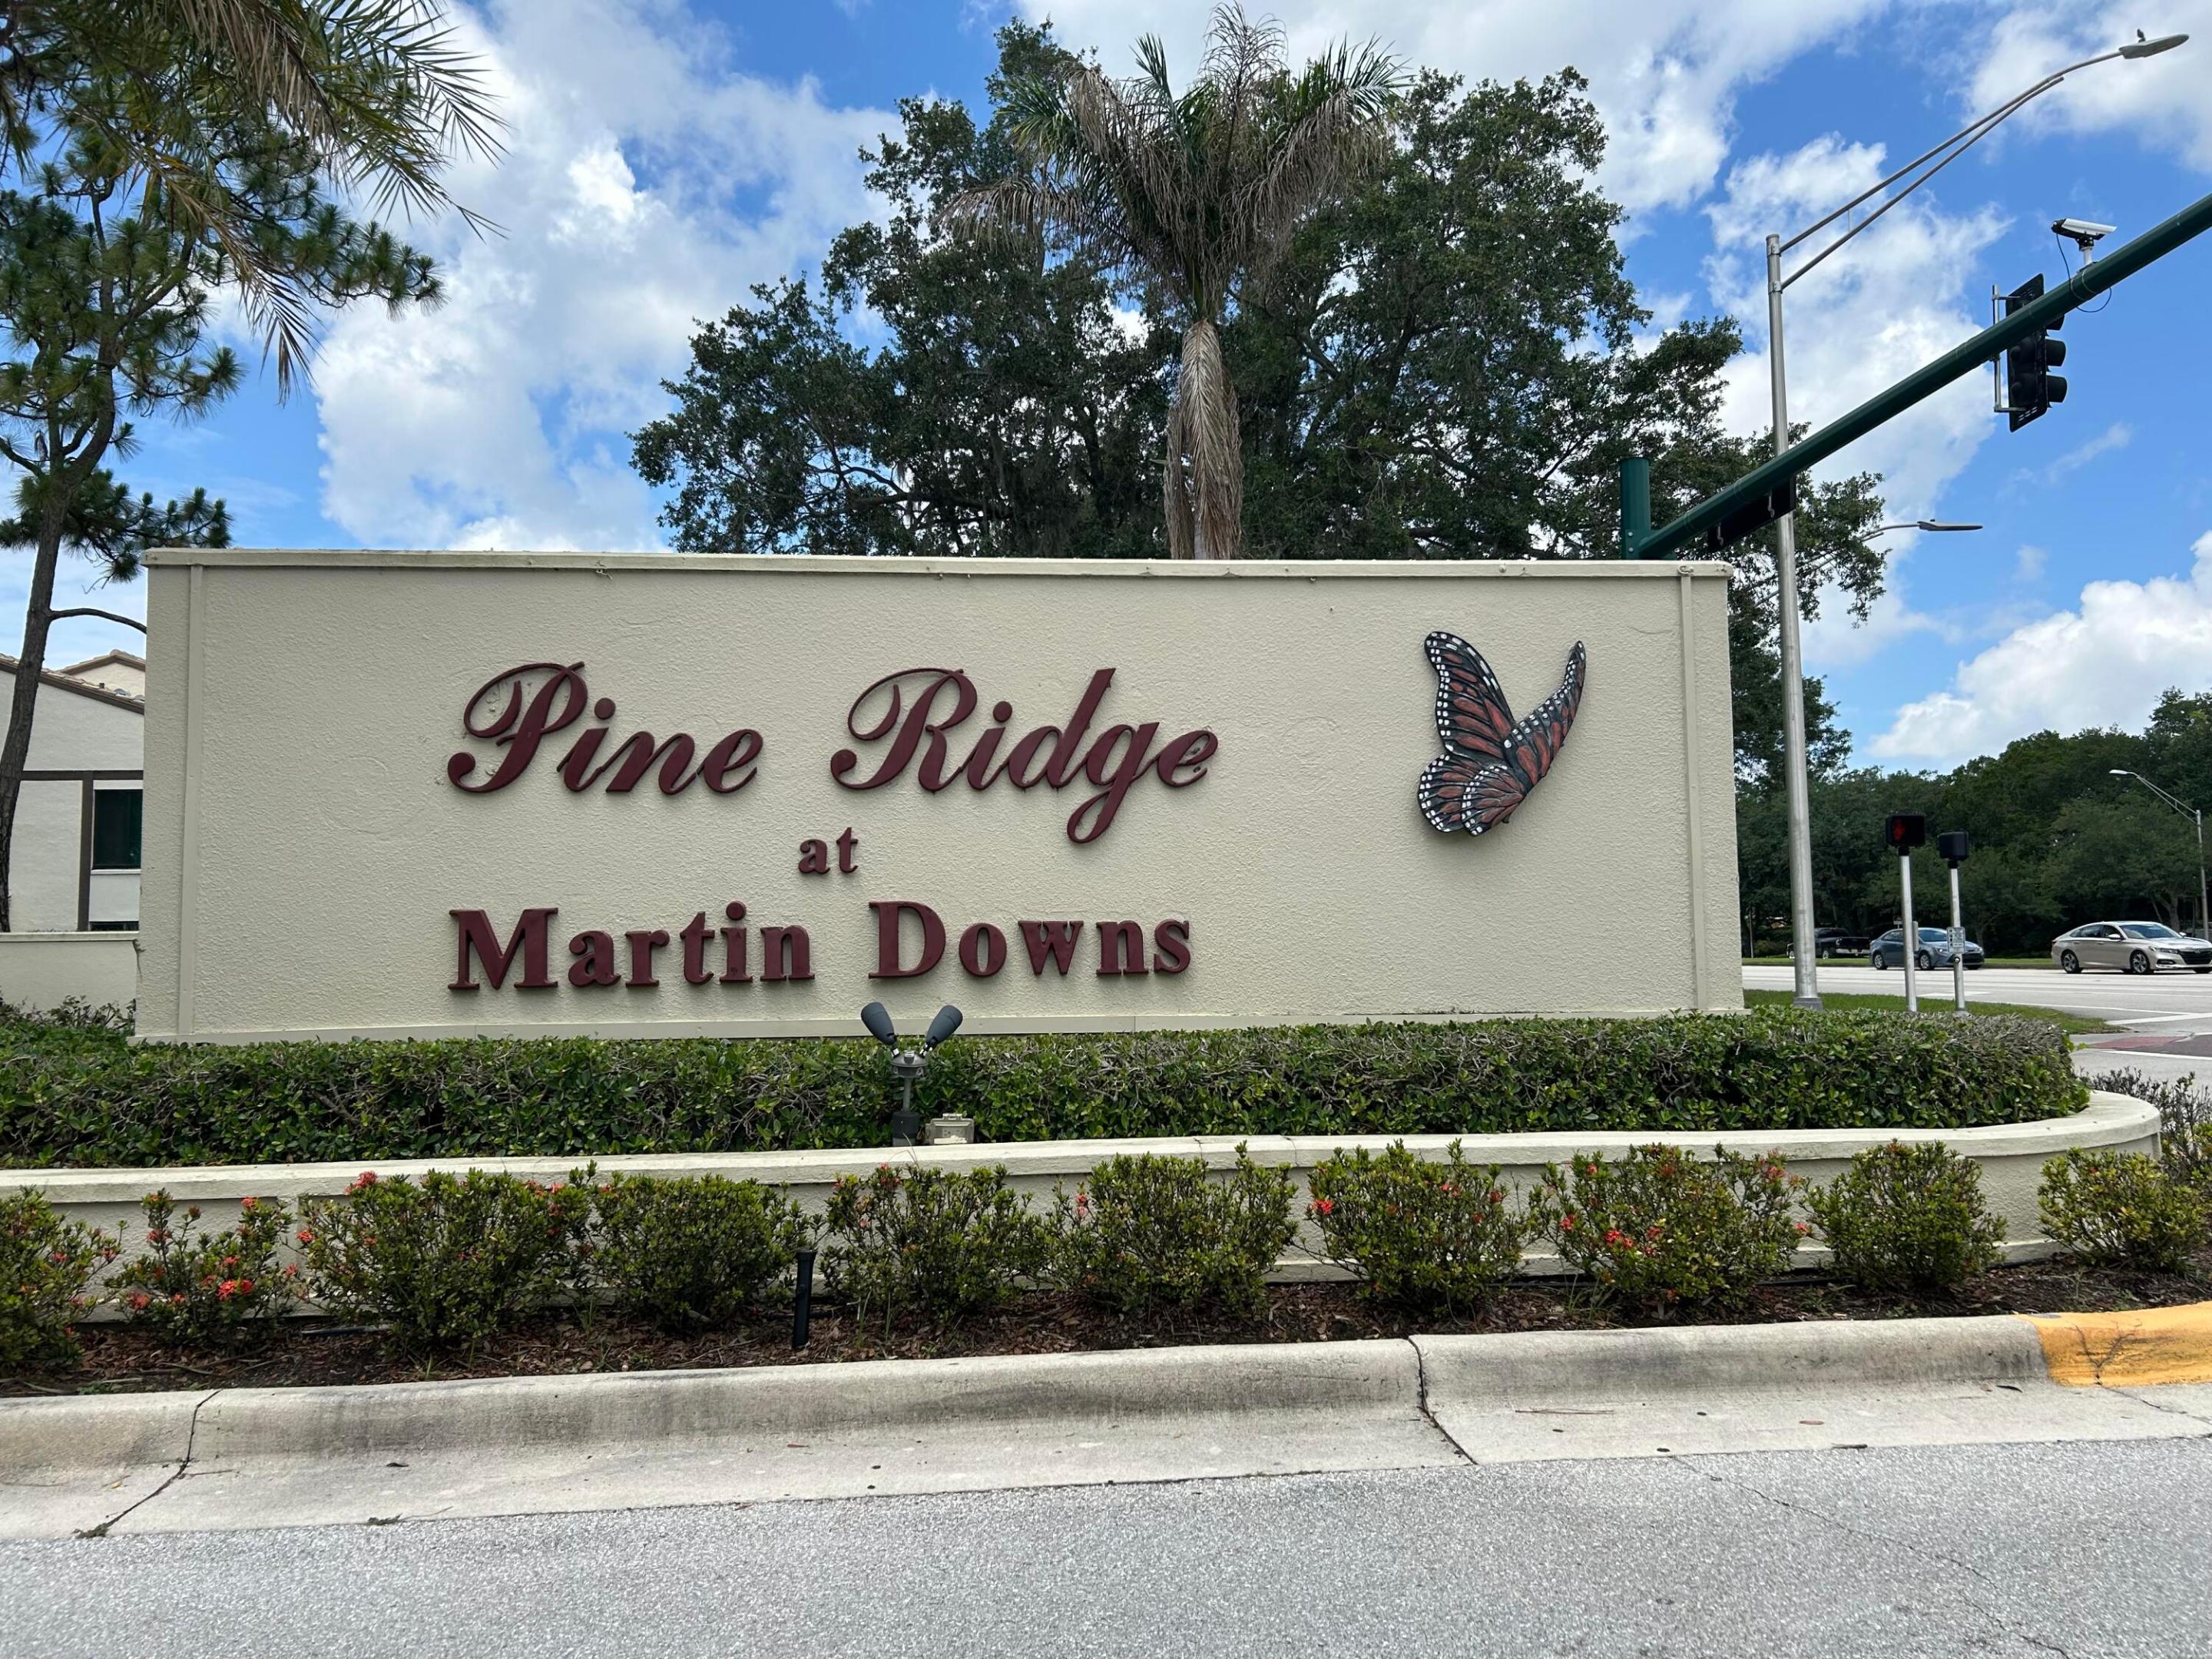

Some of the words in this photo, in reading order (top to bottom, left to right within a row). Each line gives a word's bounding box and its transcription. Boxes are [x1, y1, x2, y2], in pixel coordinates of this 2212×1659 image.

[446, 661, 763, 794] Pine
[830, 667, 1218, 844] Ridge
[797, 827, 859, 875] at
[448, 901, 815, 990] Martin
[867, 902, 1191, 980] Downs
